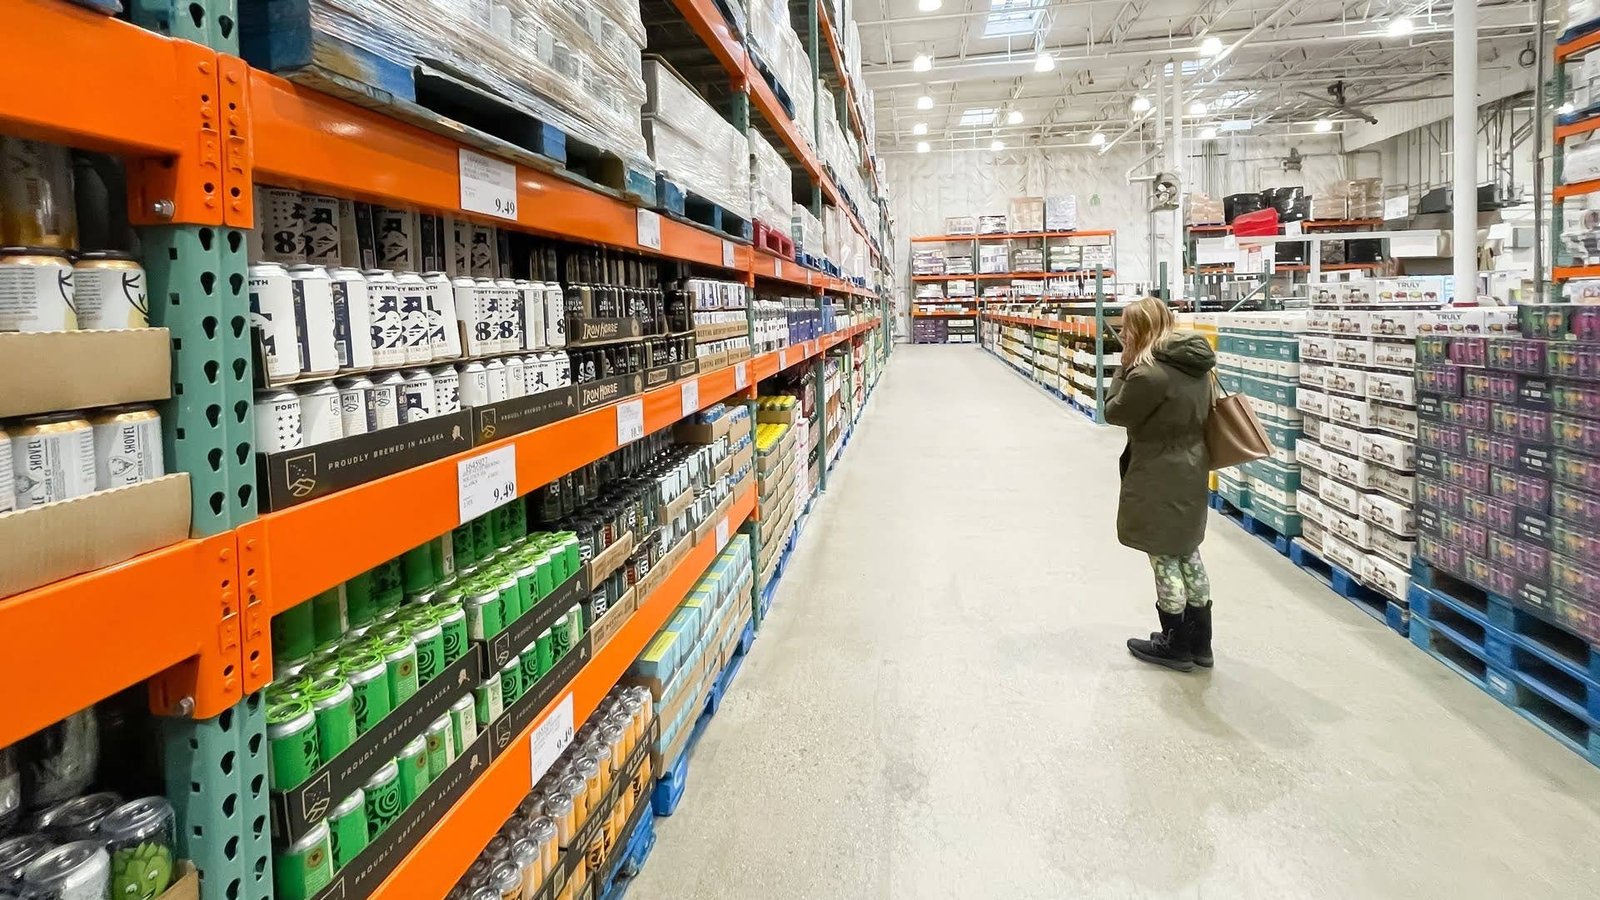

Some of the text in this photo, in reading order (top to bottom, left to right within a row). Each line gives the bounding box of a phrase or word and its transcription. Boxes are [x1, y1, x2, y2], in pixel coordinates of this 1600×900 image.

[495, 197, 515, 216] 9.49
[1436, 313, 1462, 321] TRULY
[499, 320, 514, 339] 8
[582, 321, 619, 340] IRON HORSE
[582, 382, 619, 406] IRON HORSE
[123, 425, 136, 455] SHOVEL
[328, 432, 445, 471] PROUDLY BREWED IN ALASKA
[27, 439, 43, 471] SHOVEL
[493, 481, 515, 504] 9.49
[340, 685, 451, 781] PROUDLY BREWED IN ALASKA
[355, 843, 394, 885] PROUDLY
[397, 811, 426, 844] BREWED
[438, 772, 463, 801] ALASKA
